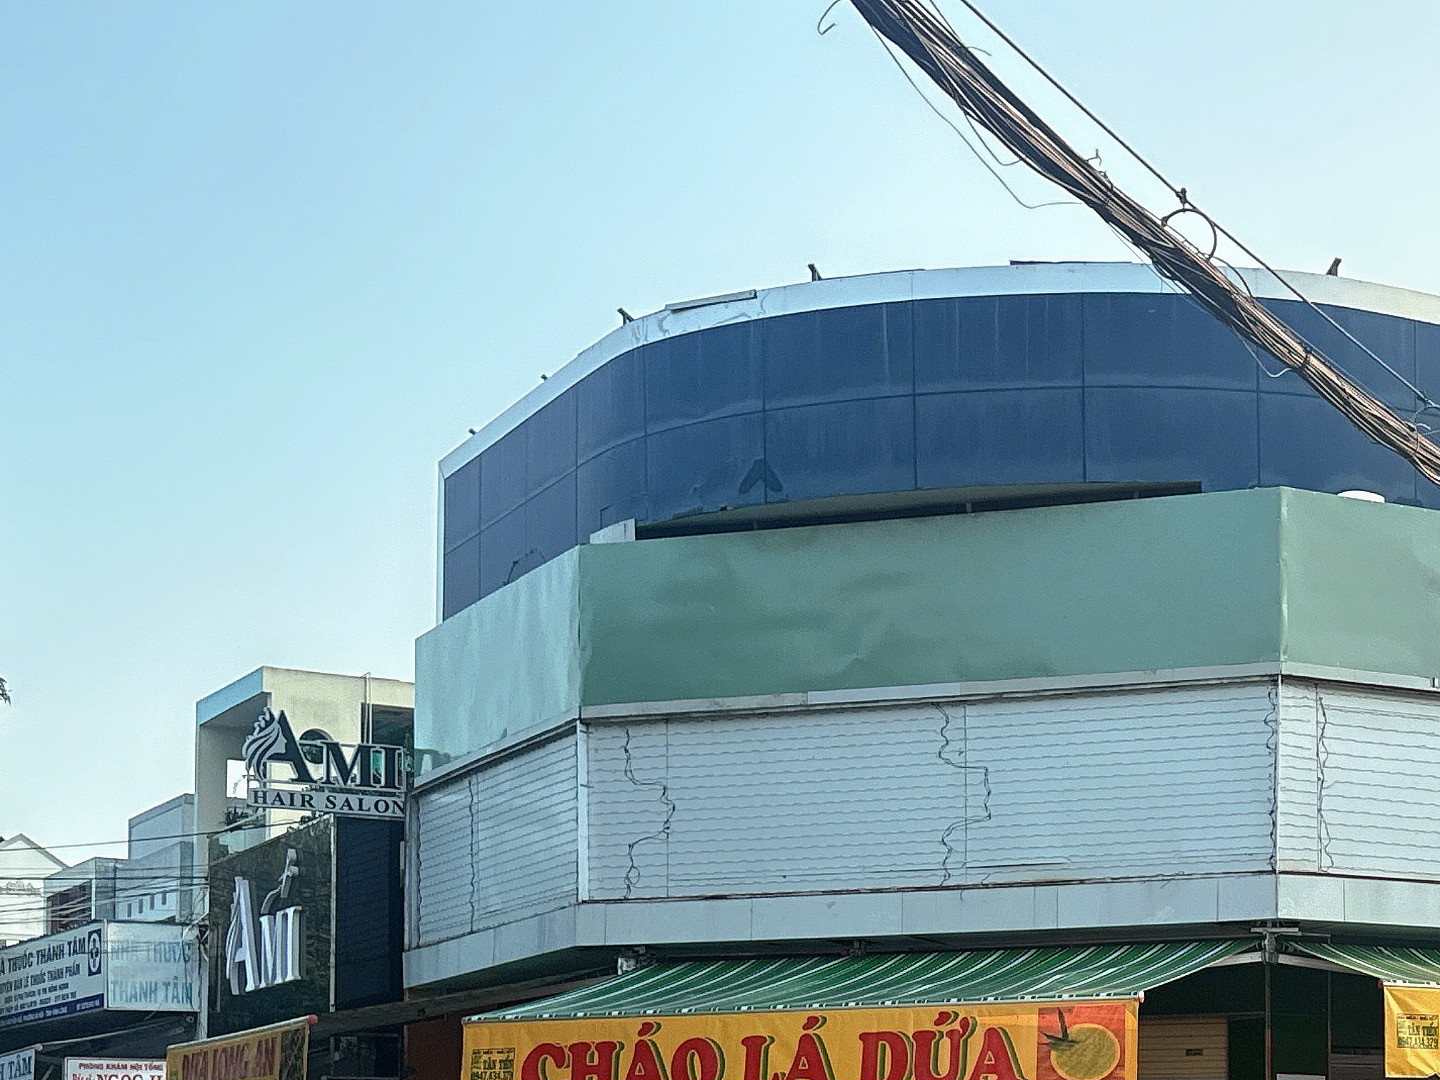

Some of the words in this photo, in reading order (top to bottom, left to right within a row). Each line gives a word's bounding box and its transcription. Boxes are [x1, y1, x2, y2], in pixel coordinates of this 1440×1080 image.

[253, 790, 315, 809] HAIR
[325, 795, 405, 815] SALON
[9, 1054, 32, 1078] TÂM
